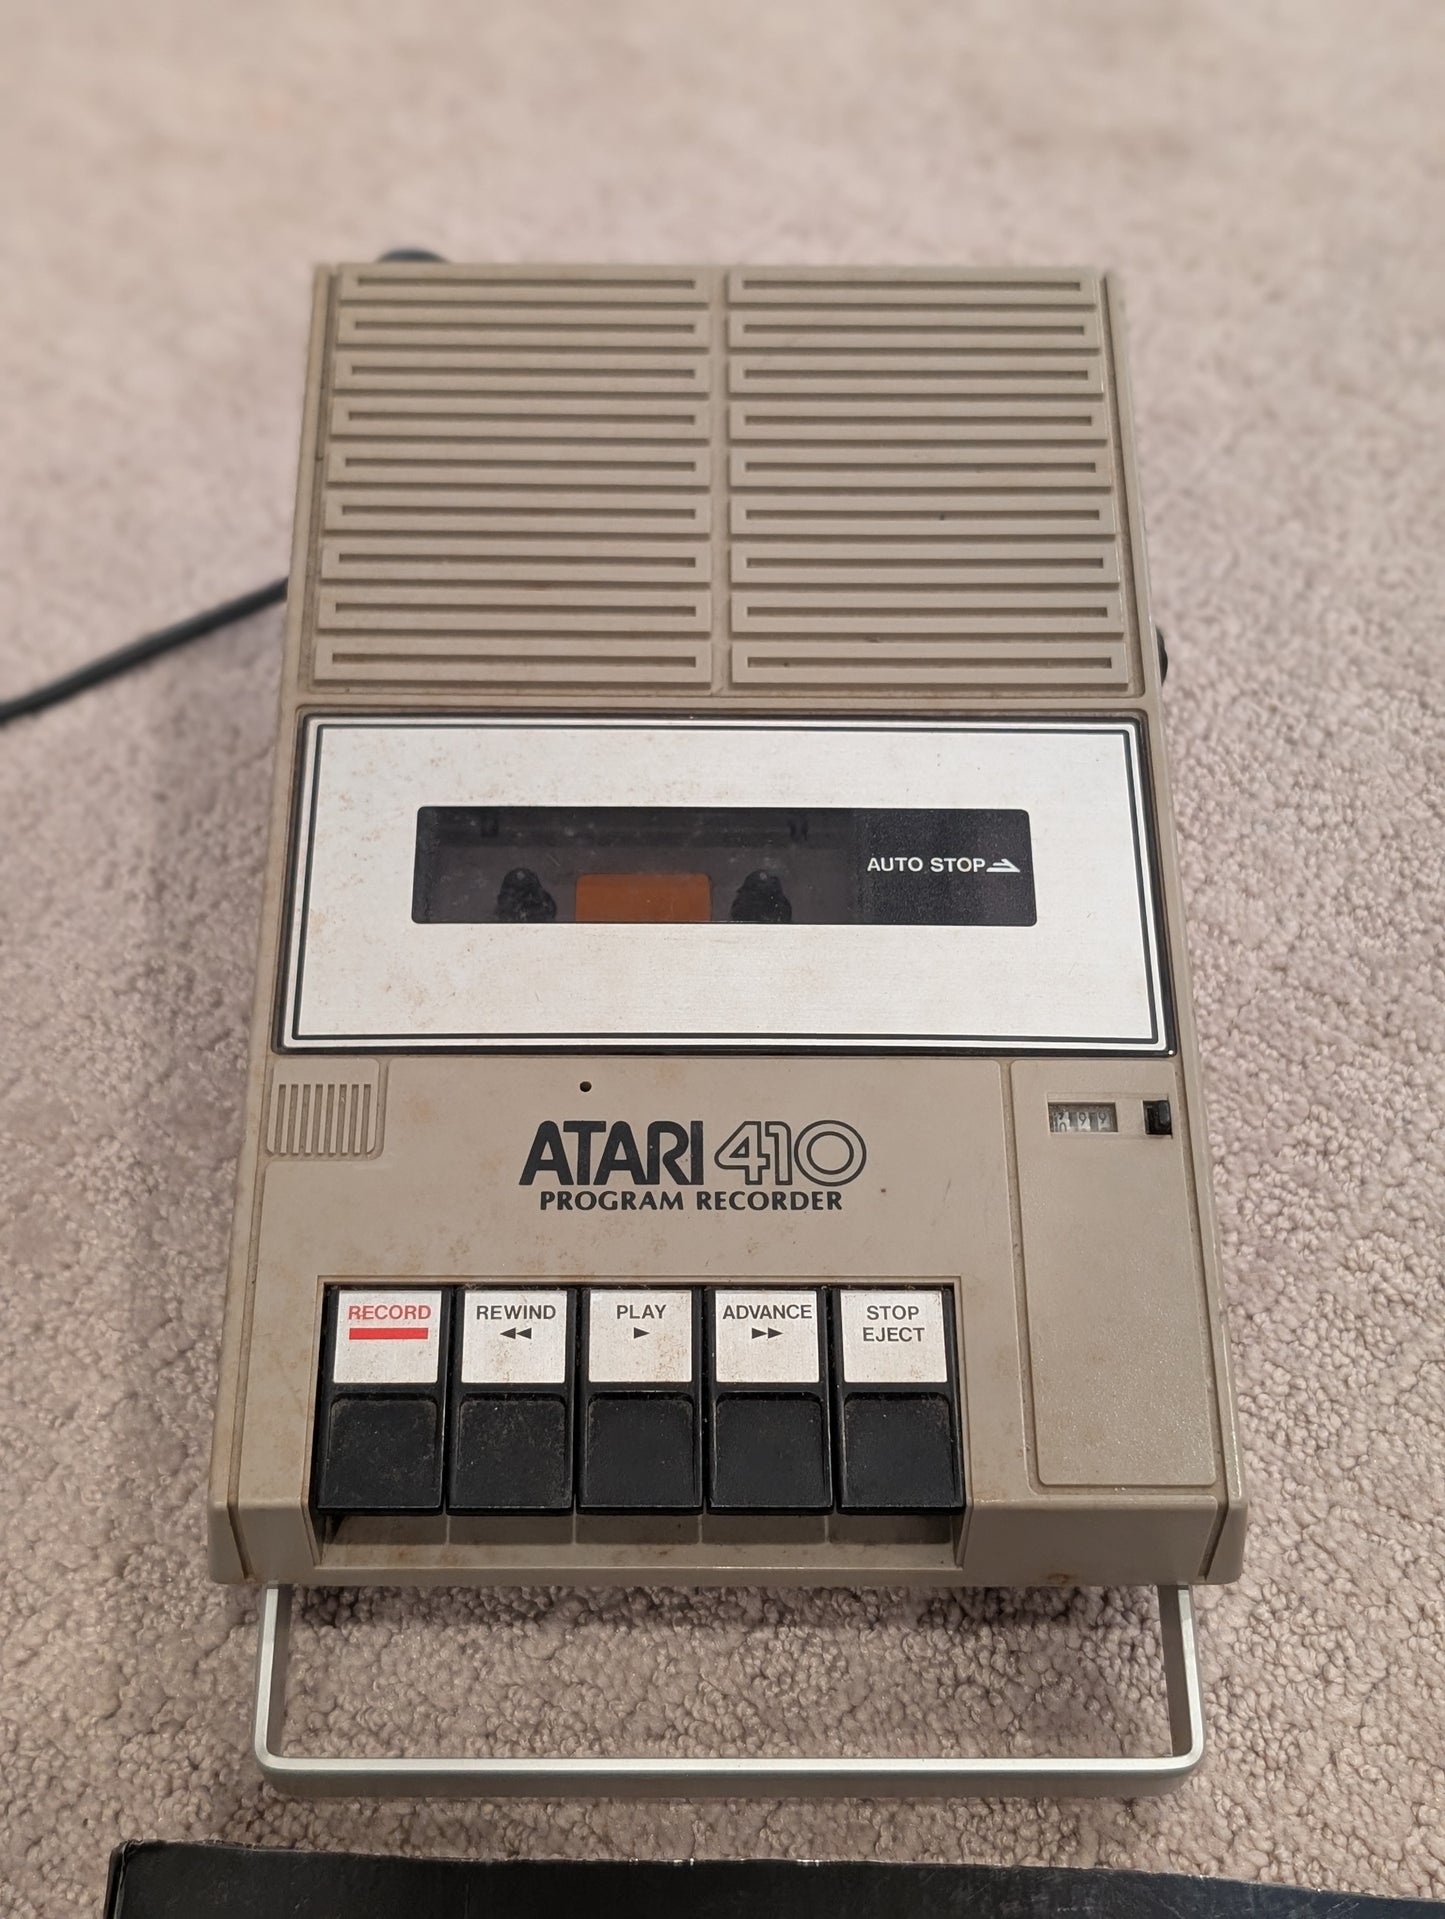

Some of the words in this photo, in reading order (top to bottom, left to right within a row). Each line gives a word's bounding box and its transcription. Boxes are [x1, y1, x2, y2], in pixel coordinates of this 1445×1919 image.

[867, 857, 923, 872] AUTO
[930, 857, 986, 872] STOP
[519, 1120, 703, 1185] ATARI
[714, 1120, 867, 1187] 410
[540, 1191, 684, 1210] PROGRAM
[696, 1191, 843, 1210] RECORDER
[348, 1304, 432, 1320] RECORD
[476, 1304, 556, 1320] REWIND
[616, 1304, 667, 1320] PLAY
[722, 1304, 813, 1320] ADVANCE
[866, 1305, 920, 1321] STOP
[862, 1327, 925, 1342] EJECT
